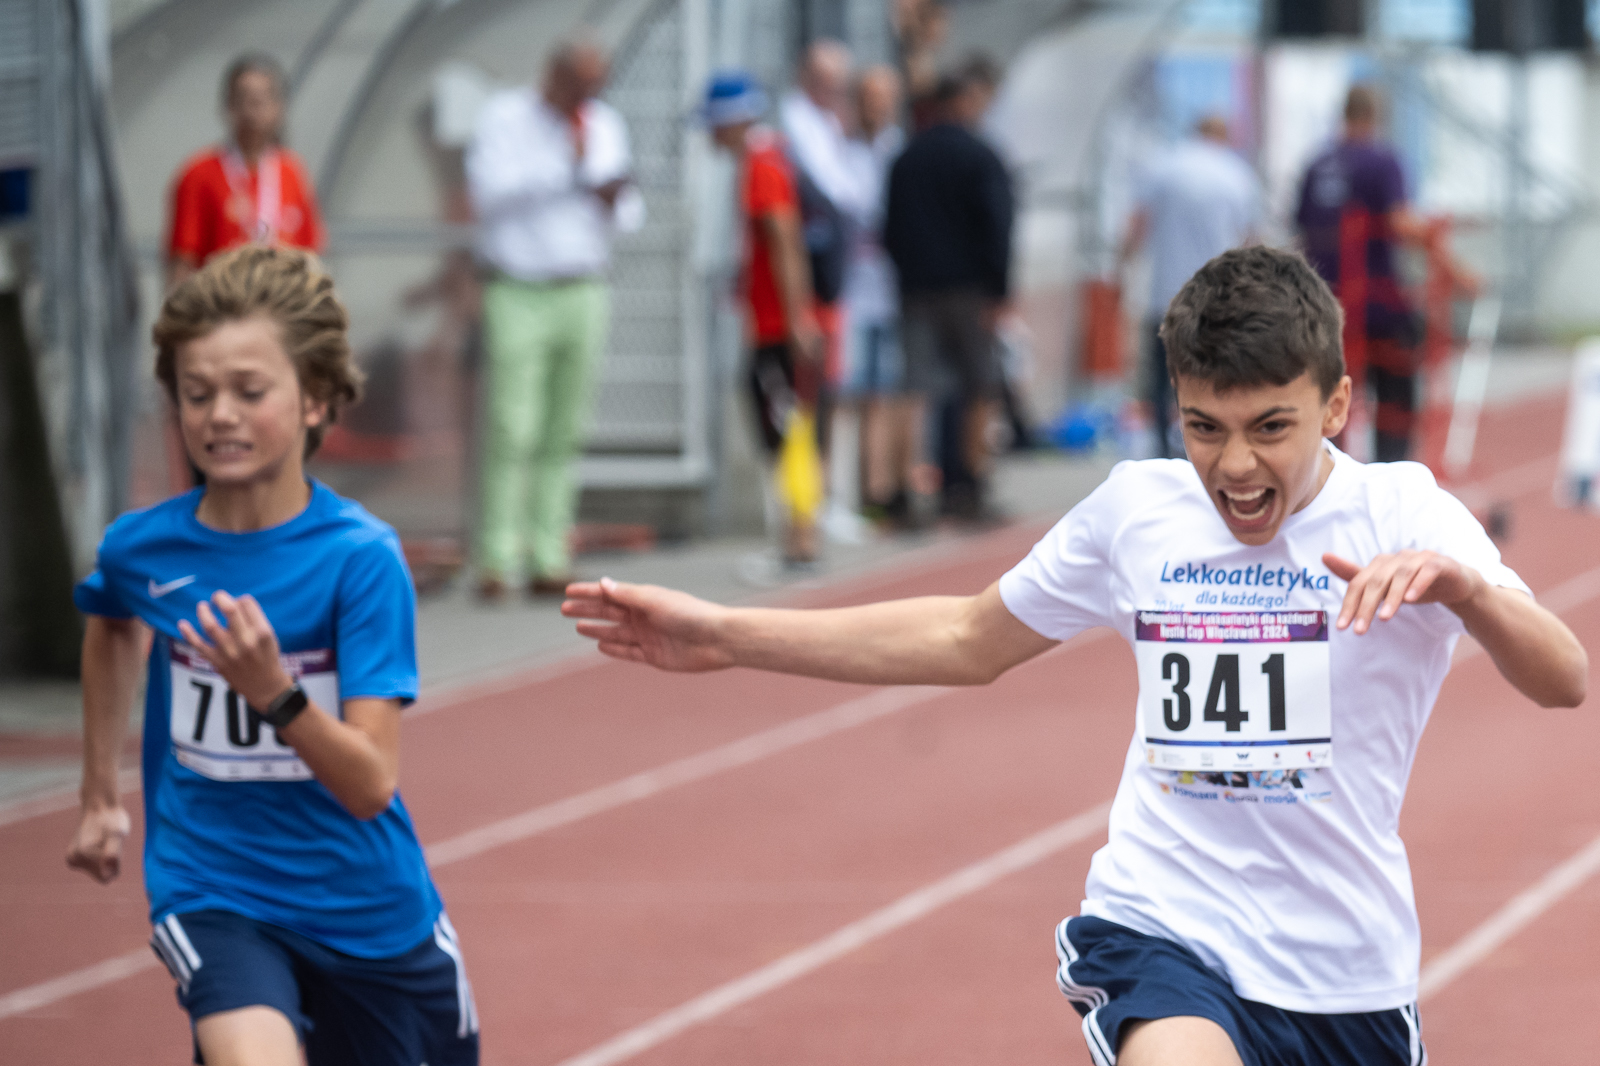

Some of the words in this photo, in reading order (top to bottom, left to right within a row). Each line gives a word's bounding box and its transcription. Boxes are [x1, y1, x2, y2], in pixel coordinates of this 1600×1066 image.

[1160, 561, 1329, 593] Lekkoatletyka
[1195, 590, 1218, 605] dla
[1220, 591, 1290, 610] każdego!
[190, 678, 295, 748] 70
[1161, 652, 1287, 732] 341
